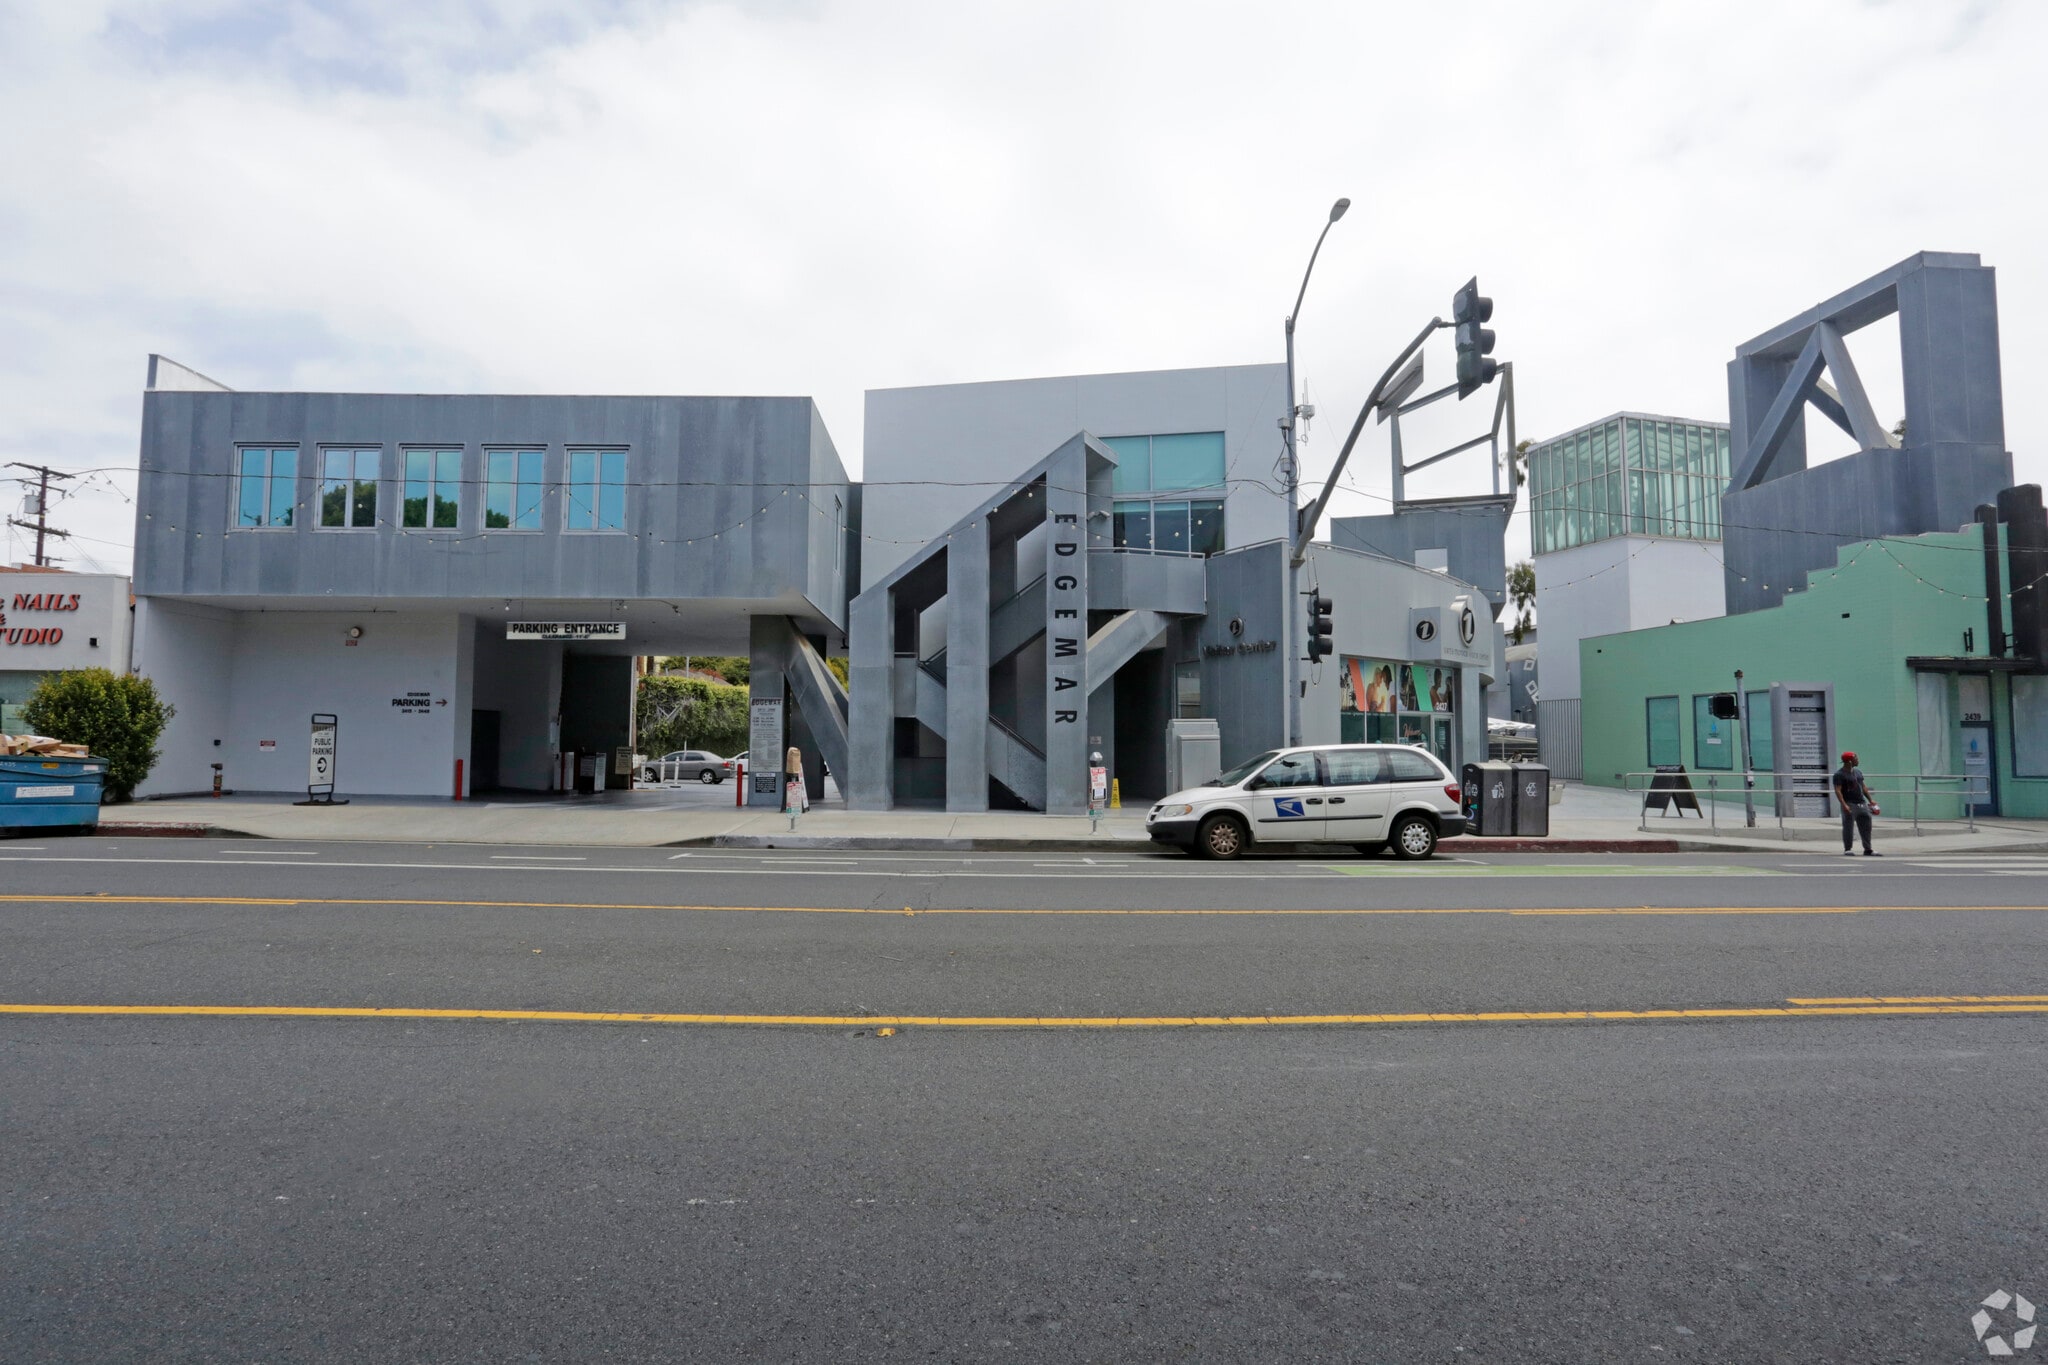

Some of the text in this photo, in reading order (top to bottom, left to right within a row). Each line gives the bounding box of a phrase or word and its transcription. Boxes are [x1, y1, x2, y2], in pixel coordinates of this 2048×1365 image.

[13, 593, 81, 611] NAILS
[1054, 513, 1078, 723] EDGEMAR
[512, 623, 620, 633] PARKING ENTRANCE
[391, 698, 431, 707] PARKING
[1964, 713, 1982, 721] 2439
[314, 738, 332, 746] PUBLIC
[312, 747, 333, 755] PARKING
